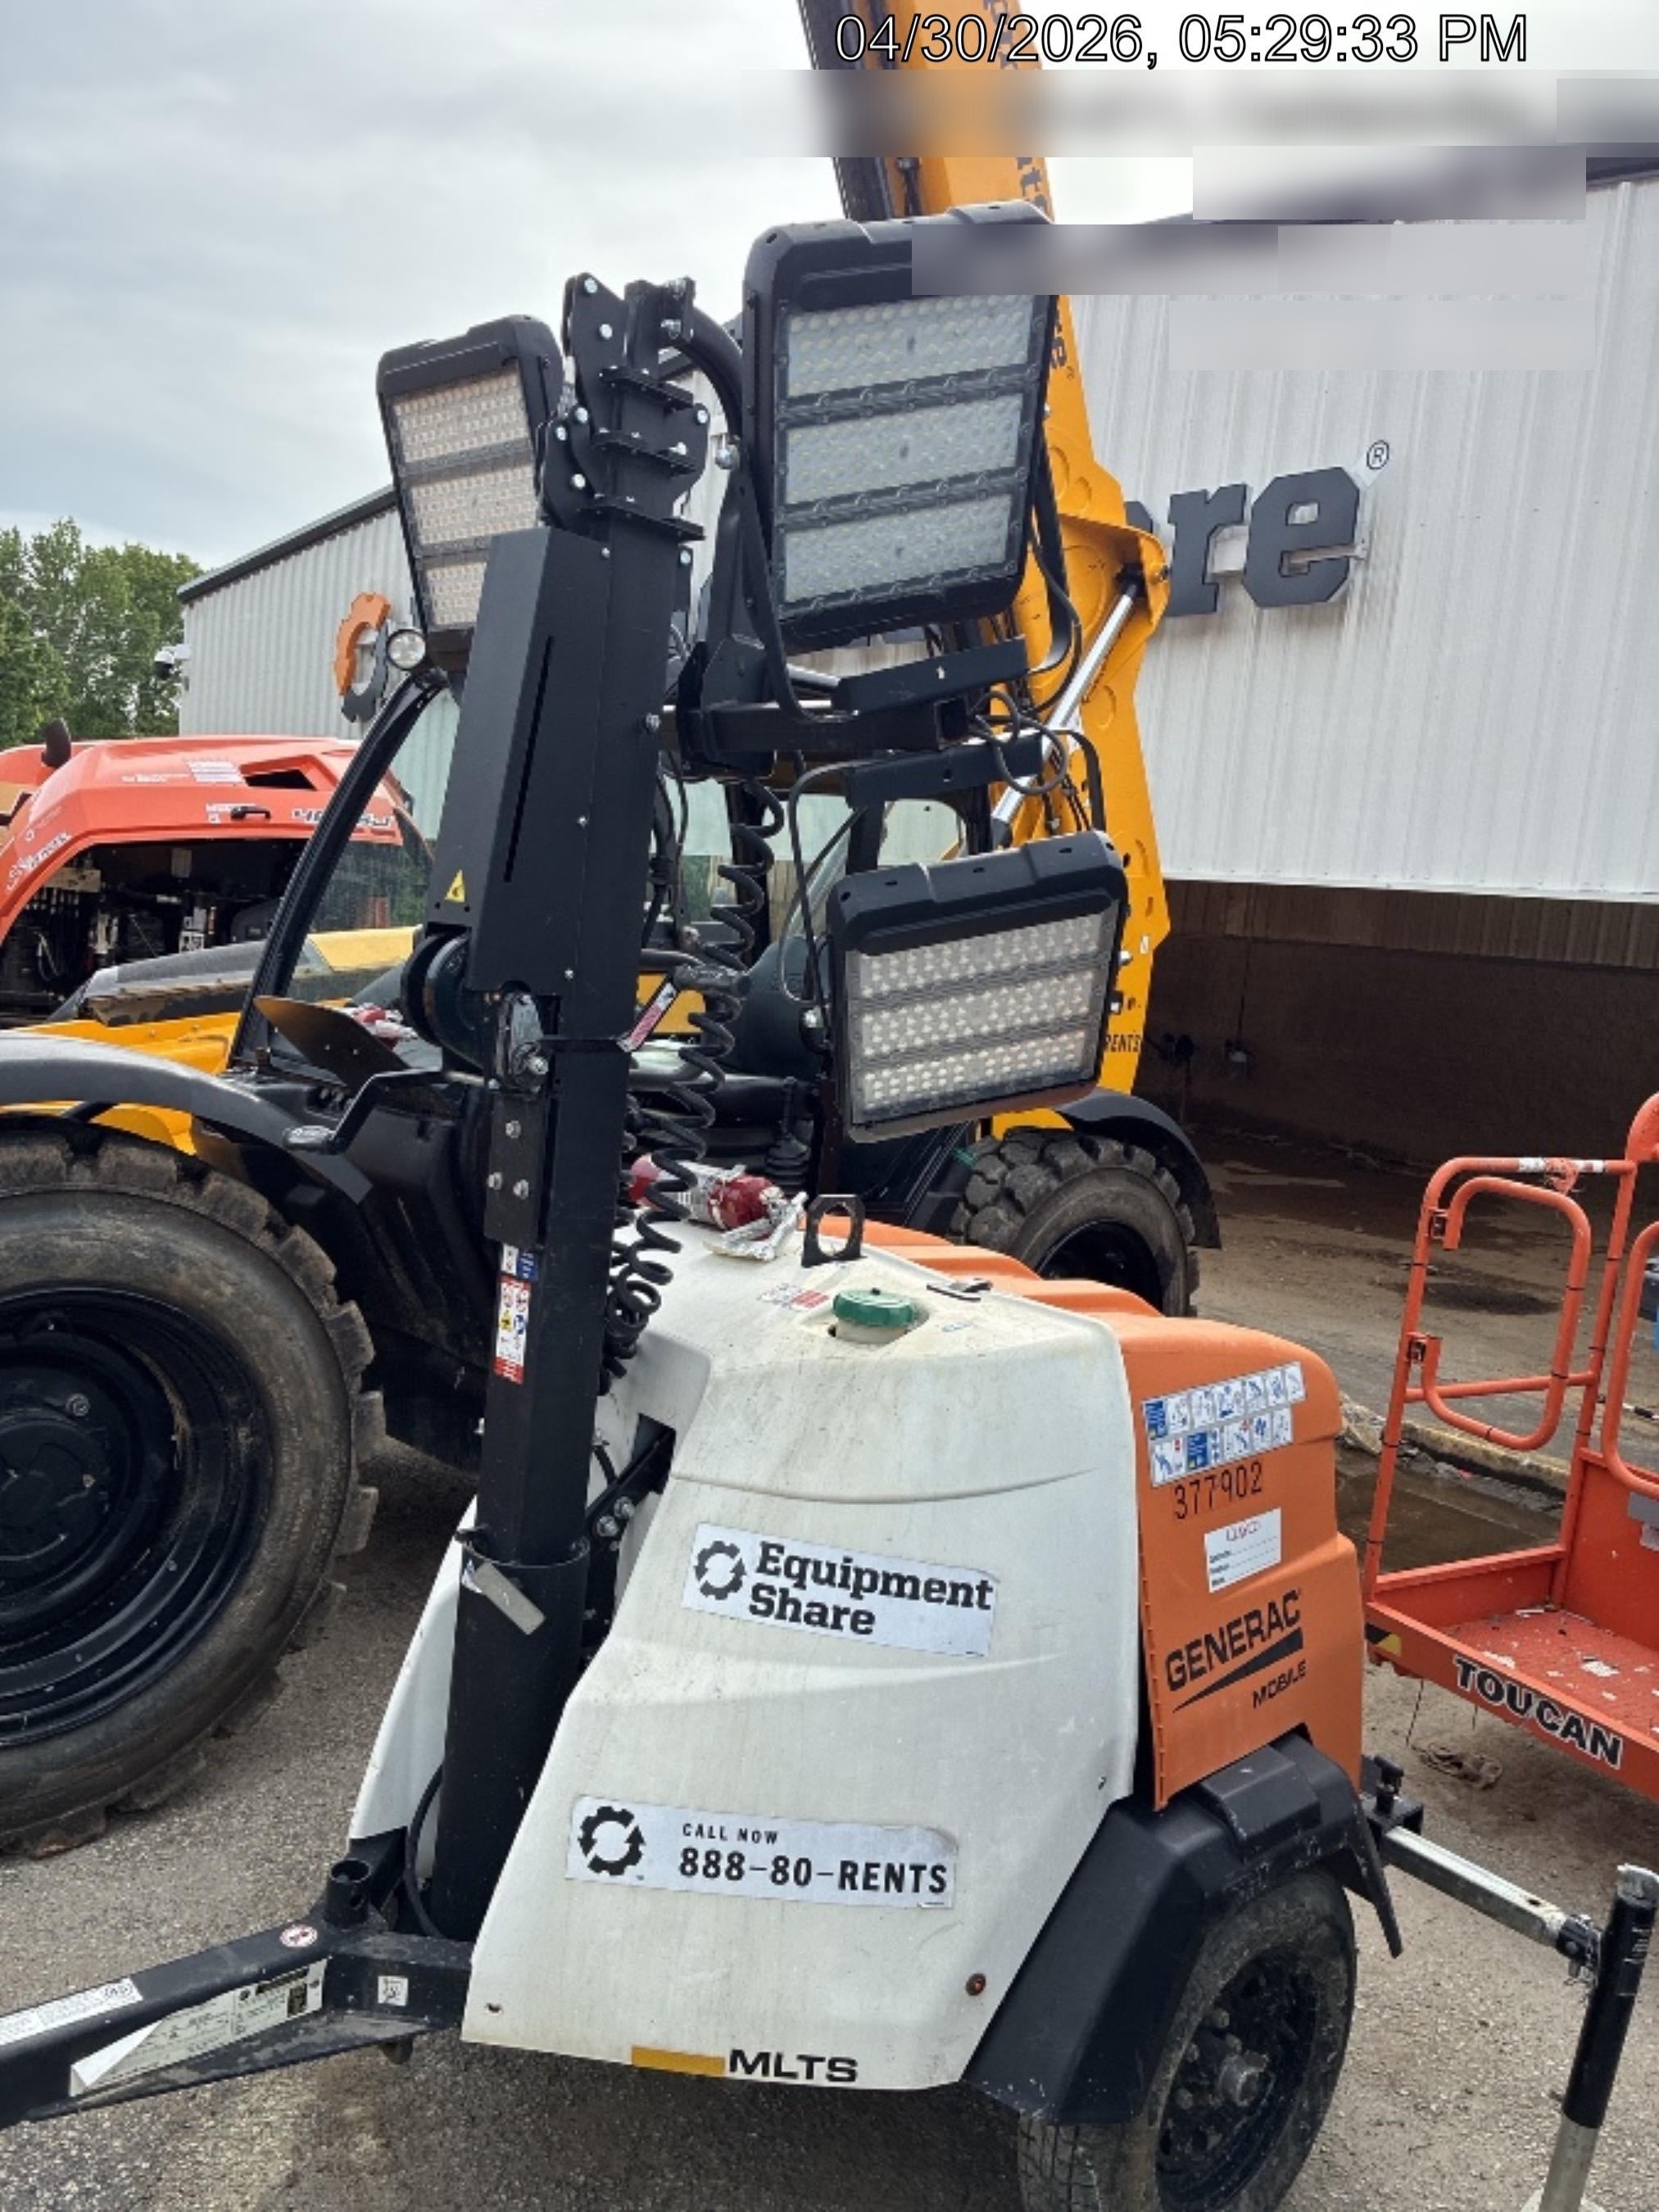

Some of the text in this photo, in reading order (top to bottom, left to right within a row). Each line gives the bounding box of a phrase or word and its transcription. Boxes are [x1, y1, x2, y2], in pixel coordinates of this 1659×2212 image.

[1174, 1461, 1263, 1521] 377902
[755, 1541, 993, 1611] Equipment
[749, 1582, 876, 1635] Share
[1165, 1588, 1302, 1692] GENERAC
[1252, 1658, 1307, 1709] MOBILE
[1454, 1654, 1623, 1770] TOUCAN
[682, 1823, 779, 1845] CALL NOW
[679, 1847, 948, 1894] 888-80-RENTS
[730, 2049, 858, 2083] MLTS
